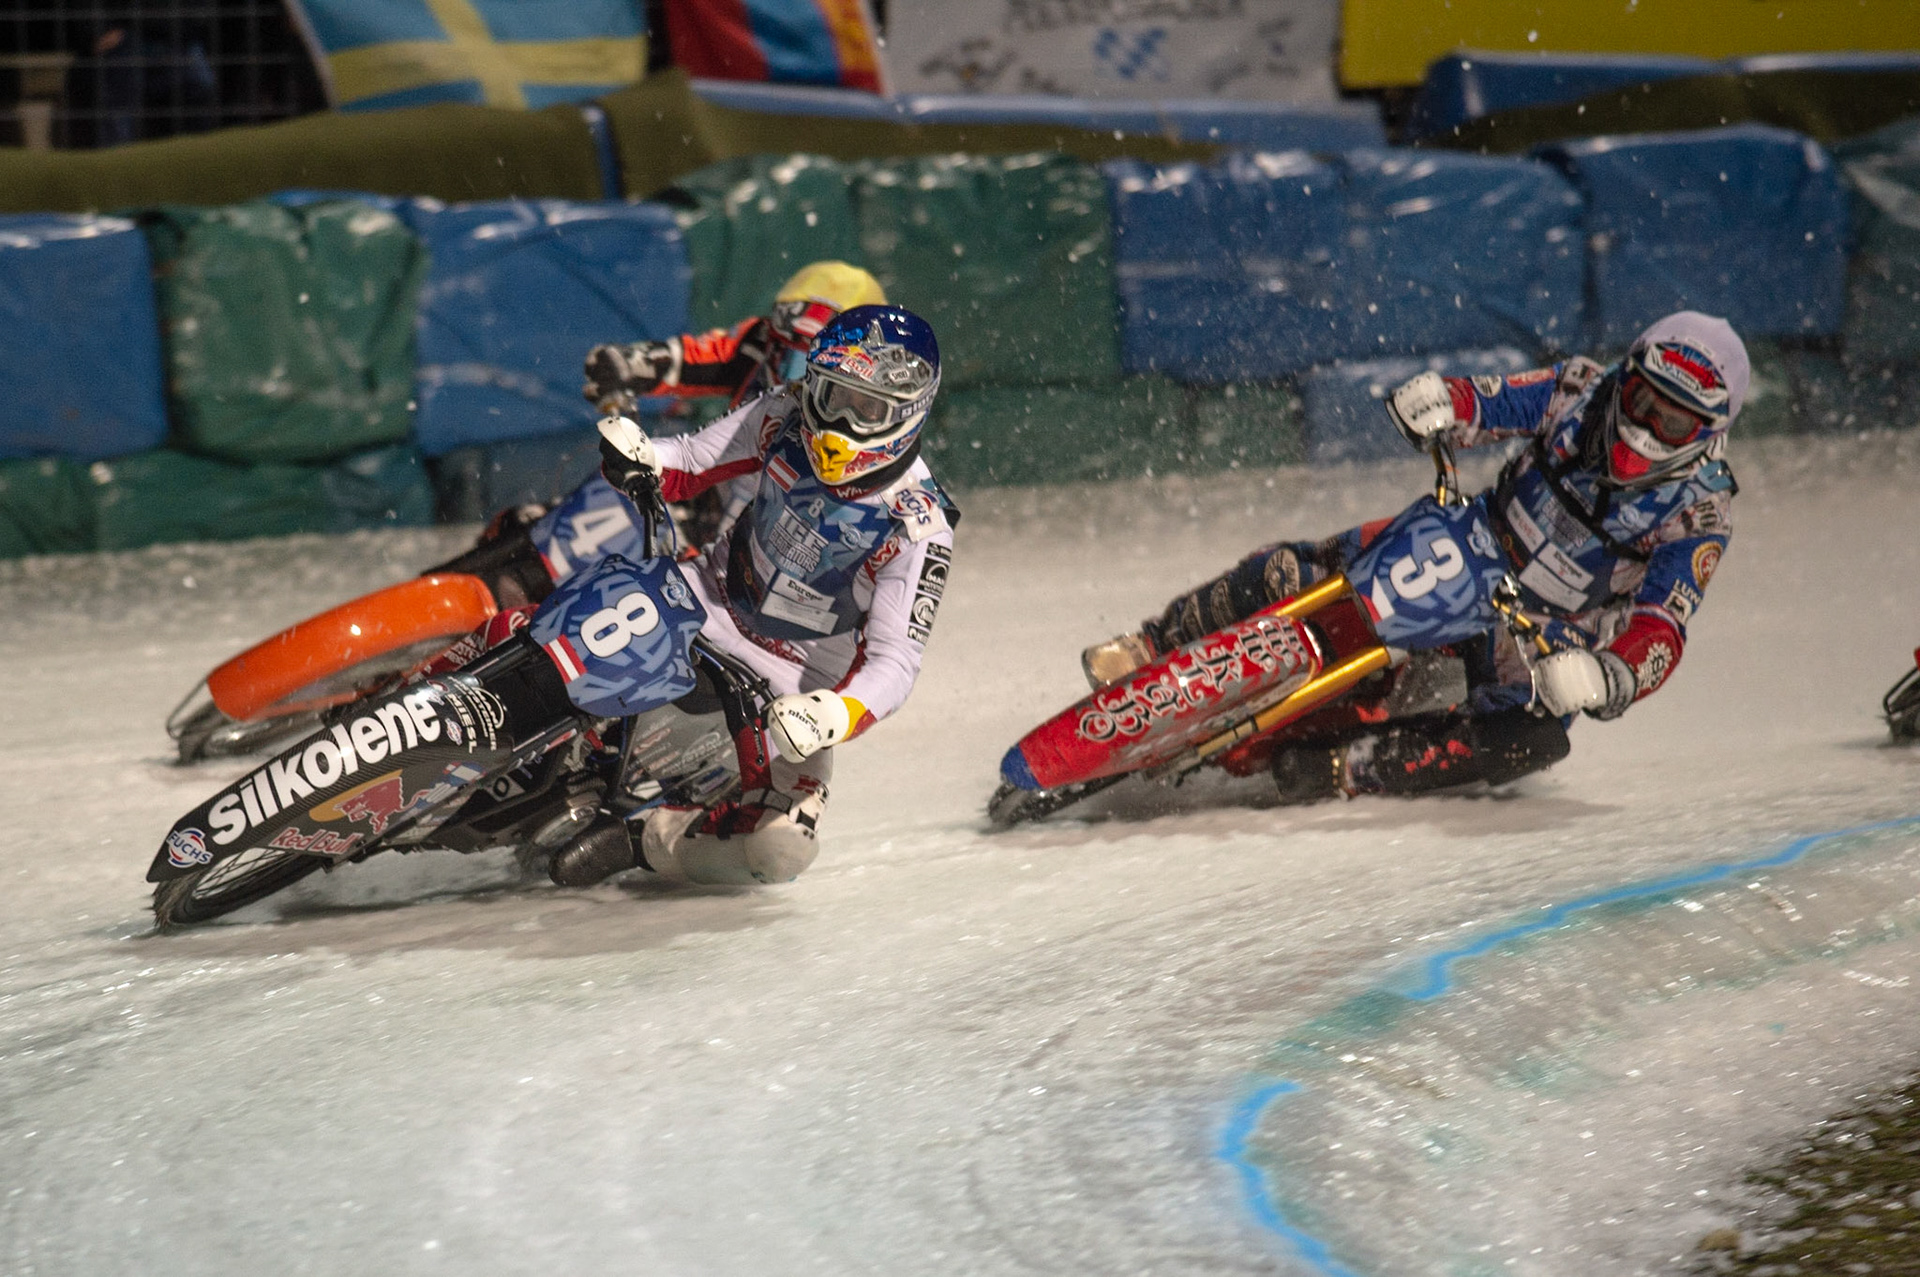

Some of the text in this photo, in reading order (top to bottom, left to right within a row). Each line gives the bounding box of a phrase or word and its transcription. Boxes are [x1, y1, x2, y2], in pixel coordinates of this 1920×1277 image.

[845, 359, 875, 379] Bull
[807, 498, 825, 519] 8
[895, 489, 932, 526] FUCHS
[569, 504, 633, 559] 4
[1389, 537, 1465, 600] 3
[788, 580, 823, 601] Europe
[580, 592, 660, 659] 8
[446, 693, 478, 754] MIESL
[207, 694, 442, 846] silkolene
[166, 829, 213, 866] FUCHS
[268, 826, 364, 856] Red Bull
